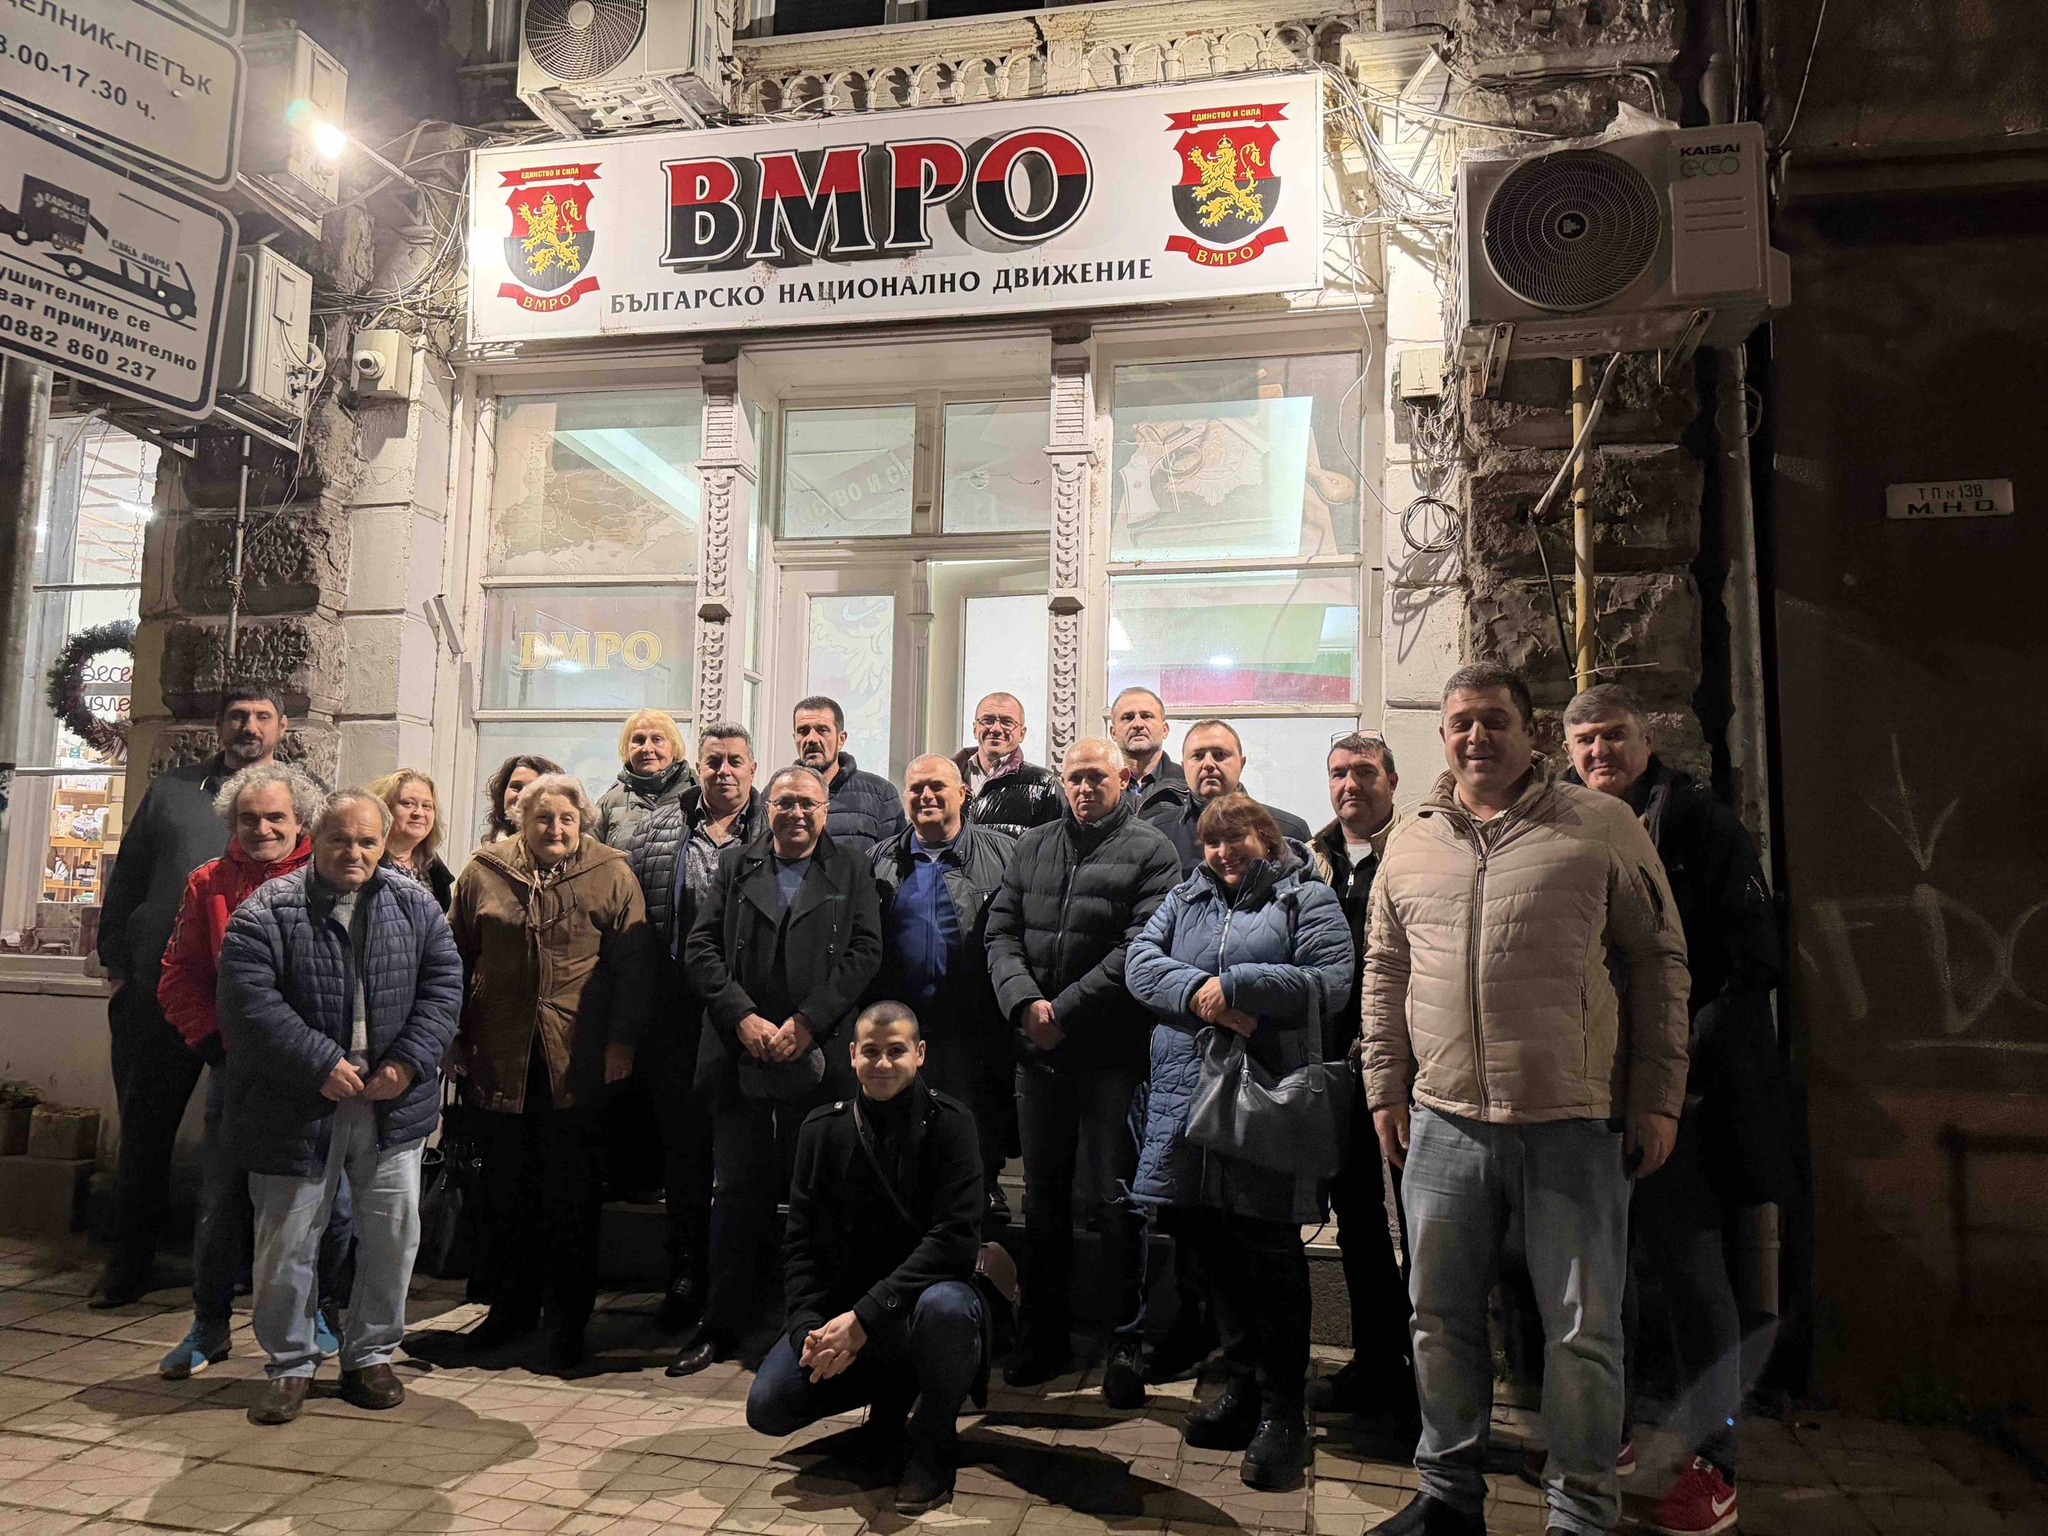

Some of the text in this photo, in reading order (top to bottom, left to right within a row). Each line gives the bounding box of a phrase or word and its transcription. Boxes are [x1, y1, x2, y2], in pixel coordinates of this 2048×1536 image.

[136, 100, 156, 120] ч.
[1192, 111, 1231, 122] ЕДИНСТВО
[1240, 109, 1261, 118] СИЛА
[1680, 143, 1740, 157] KAISAI
[521, 167, 580, 180] ЕДИНСТВО И СИЛА
[1681, 156, 1740, 178] eco
[660, 126, 1094, 268] ВМРО
[1196, 246, 1254, 265] ВМРО
[610, 257, 1153, 315] БЪЛГАРСКО НАЦИОНАЛНО ДВИЖЕНИЕ
[522, 294, 572, 311] ВМРО
[127, 315, 150, 332] се
[0, 314, 157, 381] 0882 860 237
[43, 304, 197, 371] принудително
[517, 630, 663, 671] ВМРО
